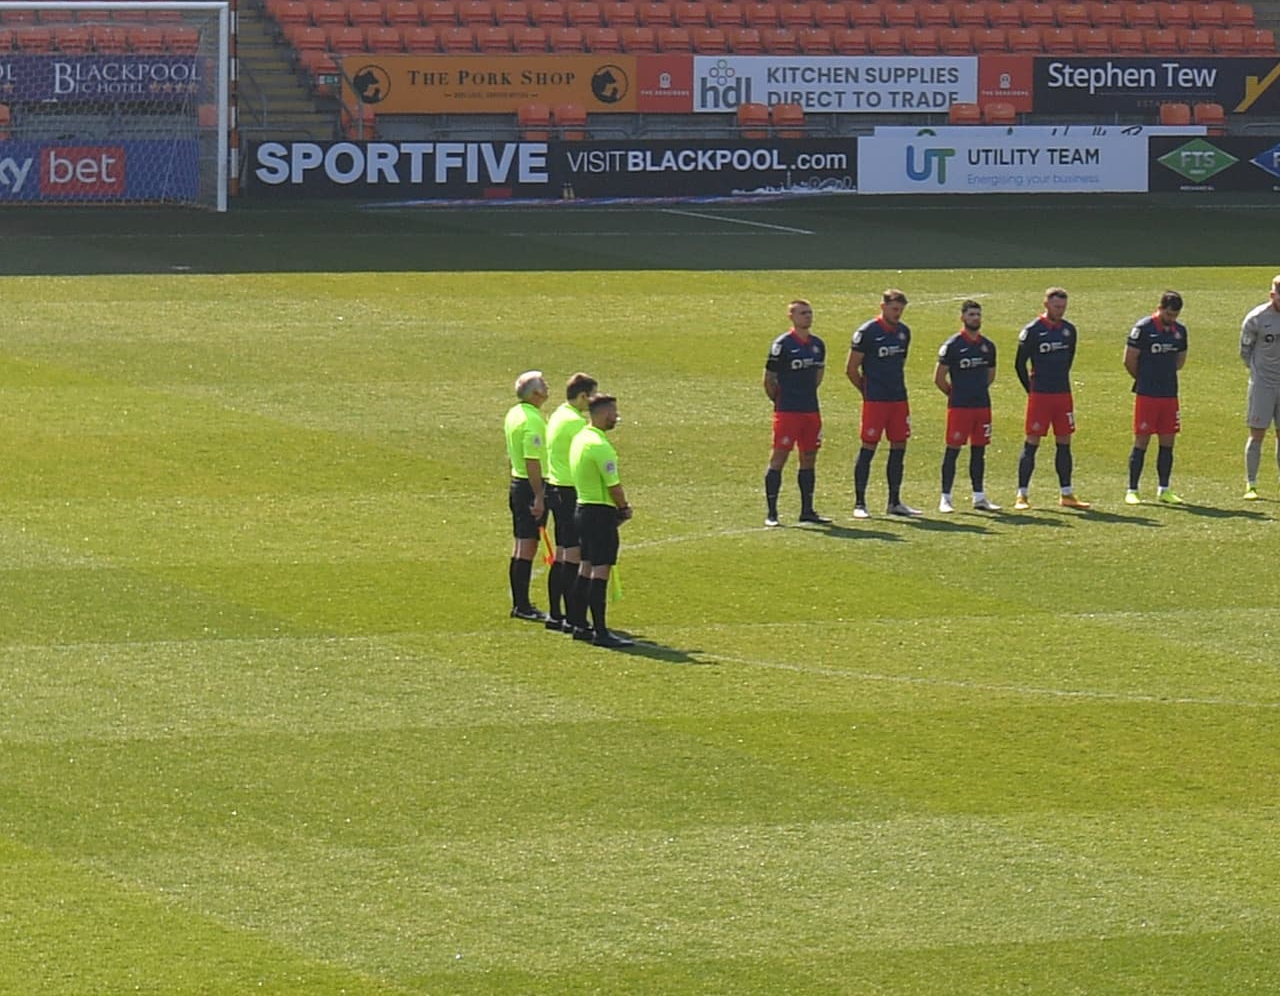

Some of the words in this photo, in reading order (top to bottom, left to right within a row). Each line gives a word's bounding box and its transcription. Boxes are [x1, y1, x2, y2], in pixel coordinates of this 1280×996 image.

[53, 62, 201, 94] BLACKPOOL
[407, 69, 450, 86] THE
[458, 69, 512, 86] PORK
[521, 69, 576, 85] SHOP
[767, 66, 860, 84] KITCHEN
[865, 66, 959, 84] SUPPLIES
[1048, 61, 1156, 94] Stephen
[1162, 63, 1216, 88] Tew
[699, 76, 752, 109] hdl
[767, 91, 846, 108] DIRECT
[852, 91, 882, 108] TO
[888, 91, 958, 108] TRADE
[49, 150, 117, 185] bet
[255, 142, 549, 185] SPORTFIVE
[906, 145, 956, 185] UT
[967, 149, 1040, 166] UTILITY
[1046, 149, 1100, 165] TEAM
[1180, 151, 1216, 169] FTS
[967, 173, 1023, 186] Energising
[1026, 175, 1050, 185] your
[1053, 173, 1100, 184] business
